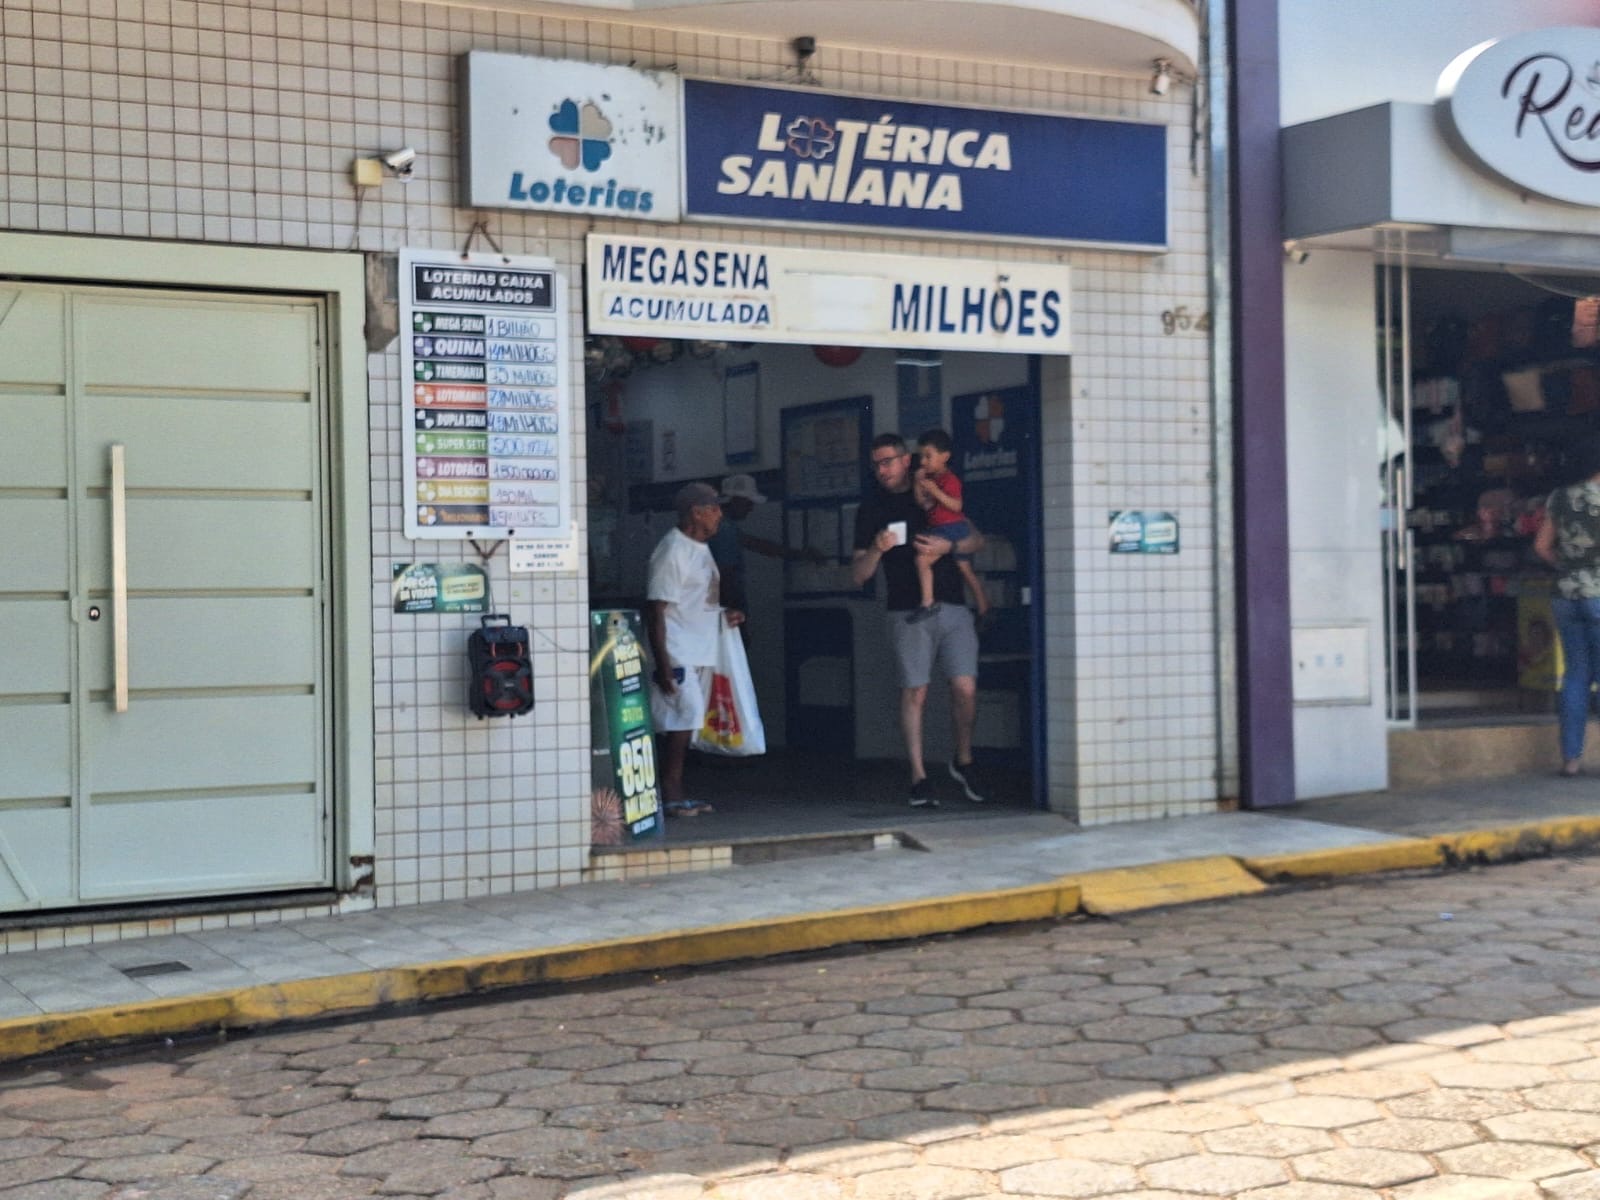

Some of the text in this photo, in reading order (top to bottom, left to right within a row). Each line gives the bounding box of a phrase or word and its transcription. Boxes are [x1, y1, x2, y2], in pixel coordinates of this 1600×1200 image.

[508, 172, 654, 213] Loterias
[716, 154, 963, 212] SANTANA
[423, 269, 545, 290] LOTERIAS CAIXA
[601, 243, 770, 291] MEGASENA
[431, 286, 534, 305] ACUMULADOS
[608, 295, 771, 326] ACUMULADA
[890, 273, 1062, 339] MILHÕES
[434, 338, 485, 356] QUINA
